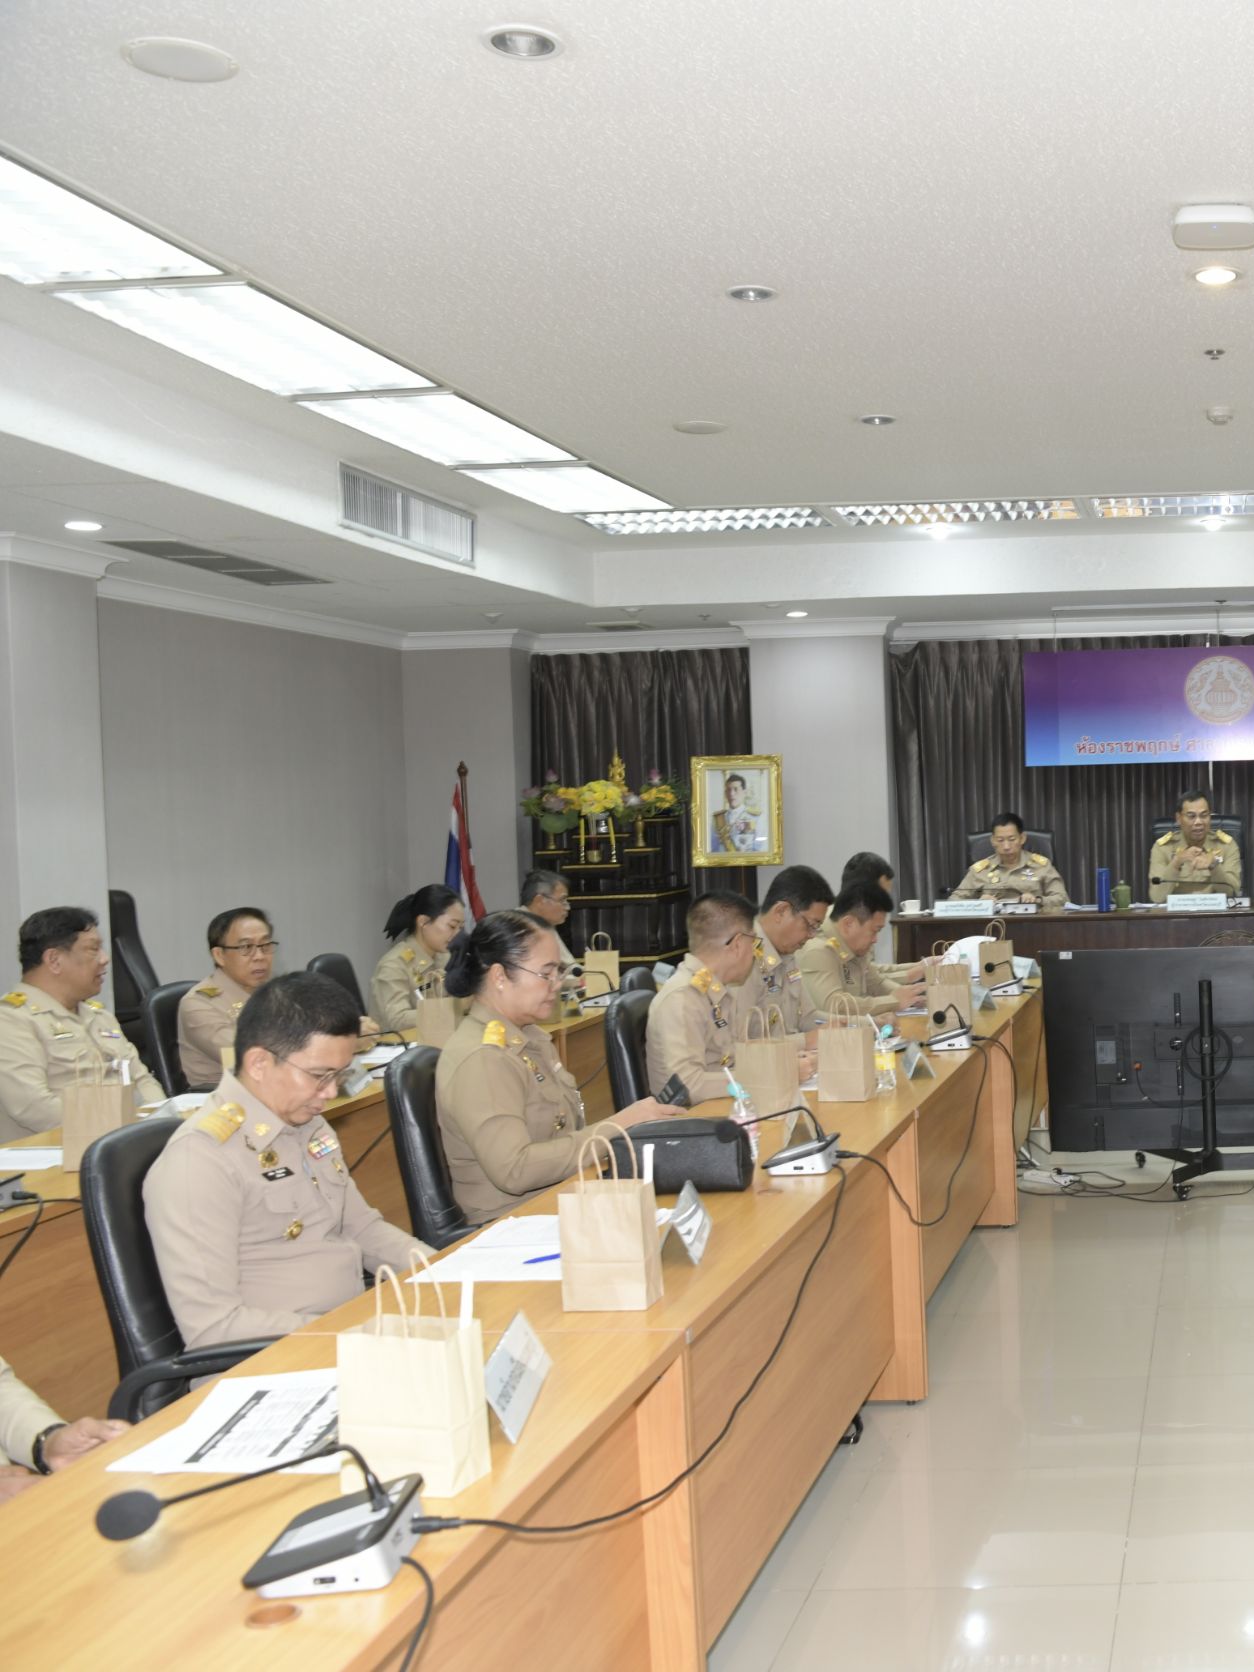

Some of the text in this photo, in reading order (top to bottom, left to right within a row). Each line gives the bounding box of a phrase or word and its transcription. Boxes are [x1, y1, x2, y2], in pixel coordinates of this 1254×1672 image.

[1075, 732, 1182, 757] ห้องราชพฤกษ์
